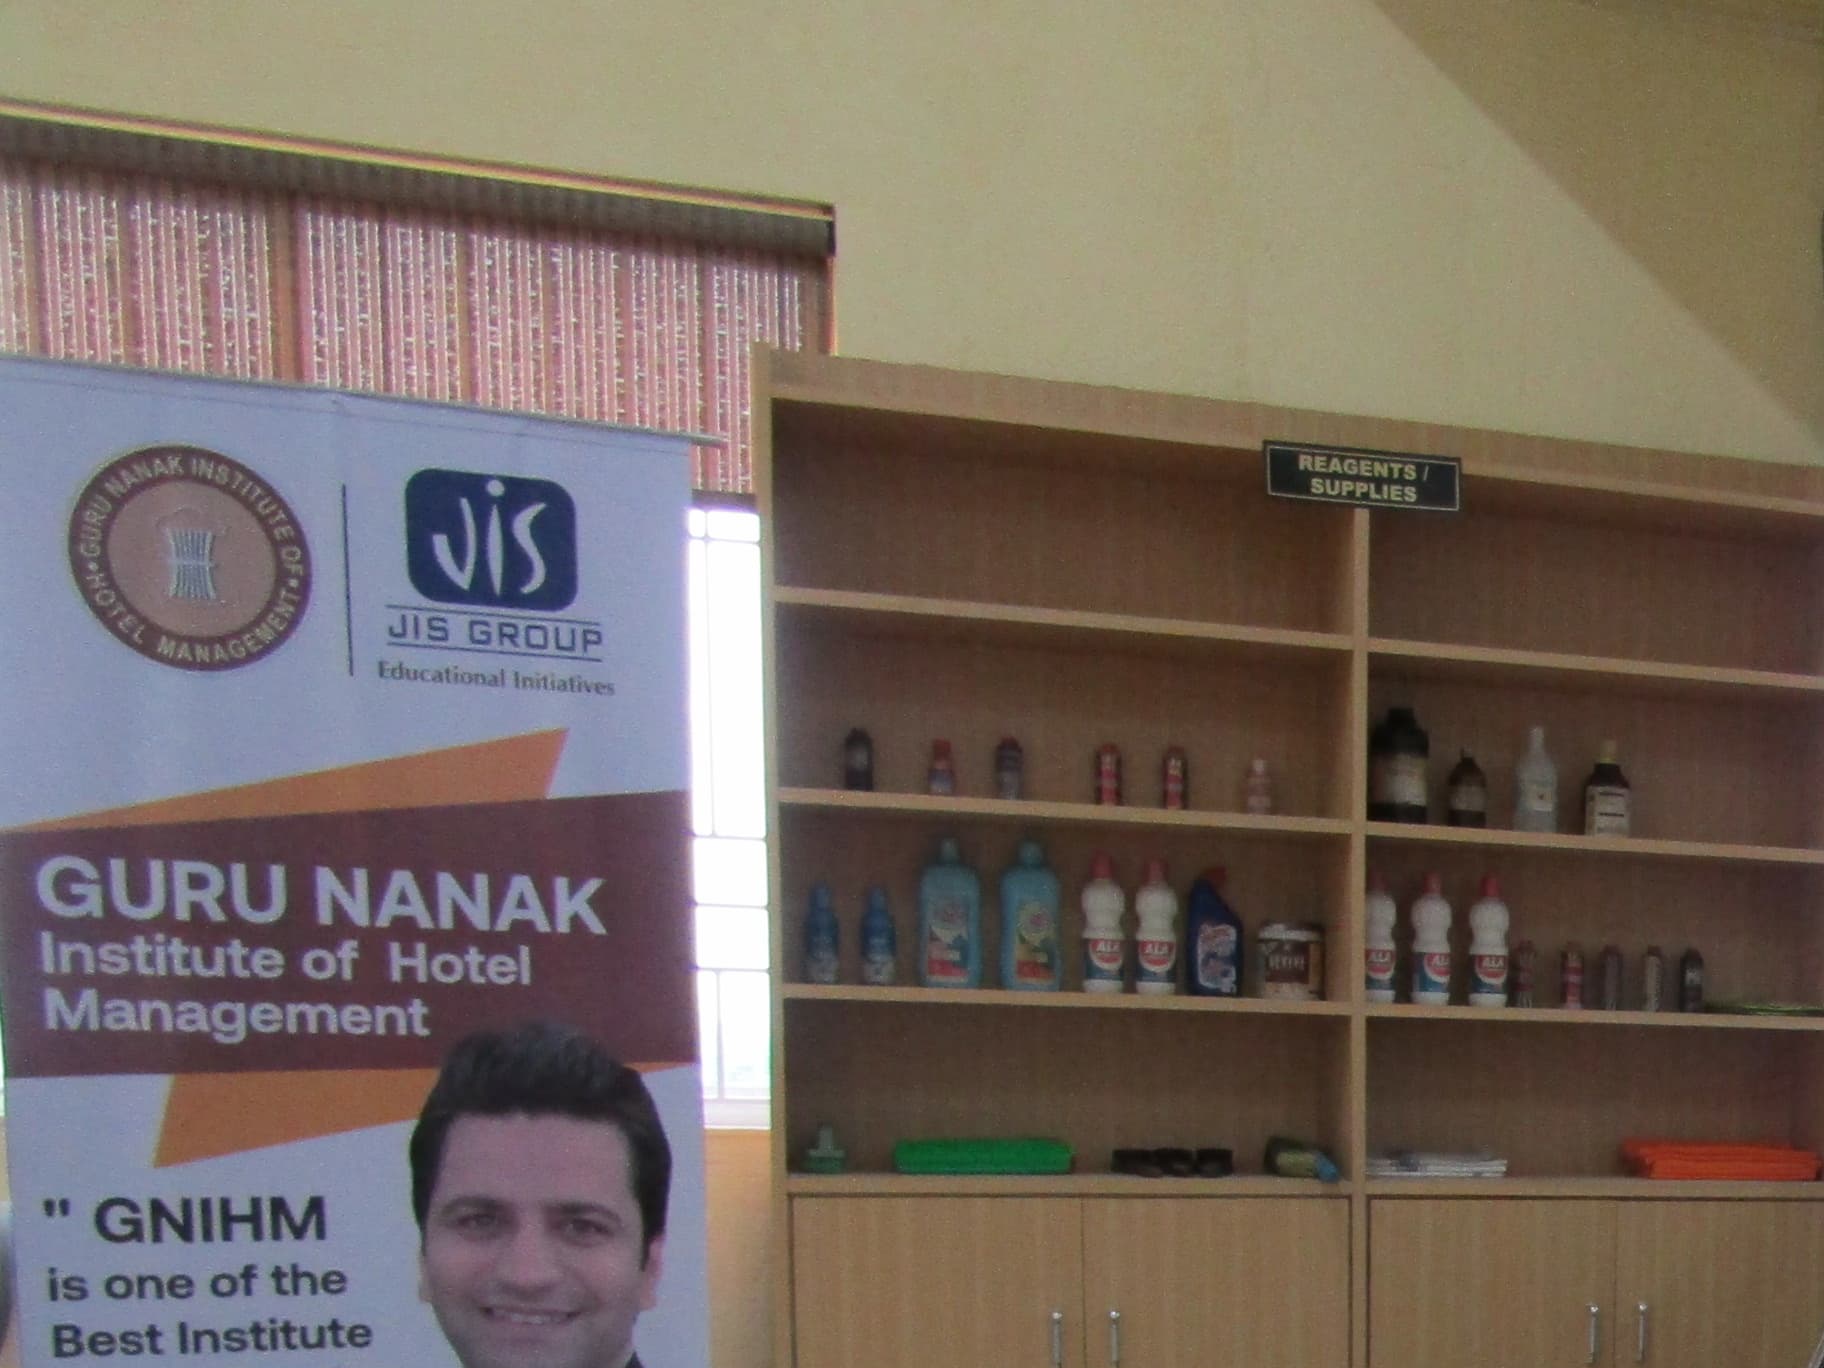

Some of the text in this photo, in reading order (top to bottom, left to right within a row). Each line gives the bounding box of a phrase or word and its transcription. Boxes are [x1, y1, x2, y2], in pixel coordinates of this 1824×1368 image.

[1298, 453, 1417, 480] REAGENTS
[1310, 478, 1417, 502] SUPPLIES
[80, 455, 304, 578] GURU NANAK INSTITUTE OF
[85, 570, 301, 664] HOTEL MANAGEMENT
[389, 614, 602, 652] JIS GROUP
[378, 660, 614, 696] Educational Initiatives
[36, 854, 607, 936] GURU NANAK
[40, 932, 531, 986] Institute of Hotel
[44, 988, 430, 1046] Management
[95, 1195, 327, 1244] GNIHM
[49, 1263, 347, 1301] is one of the
[53, 1317, 373, 1358] Best Institute
